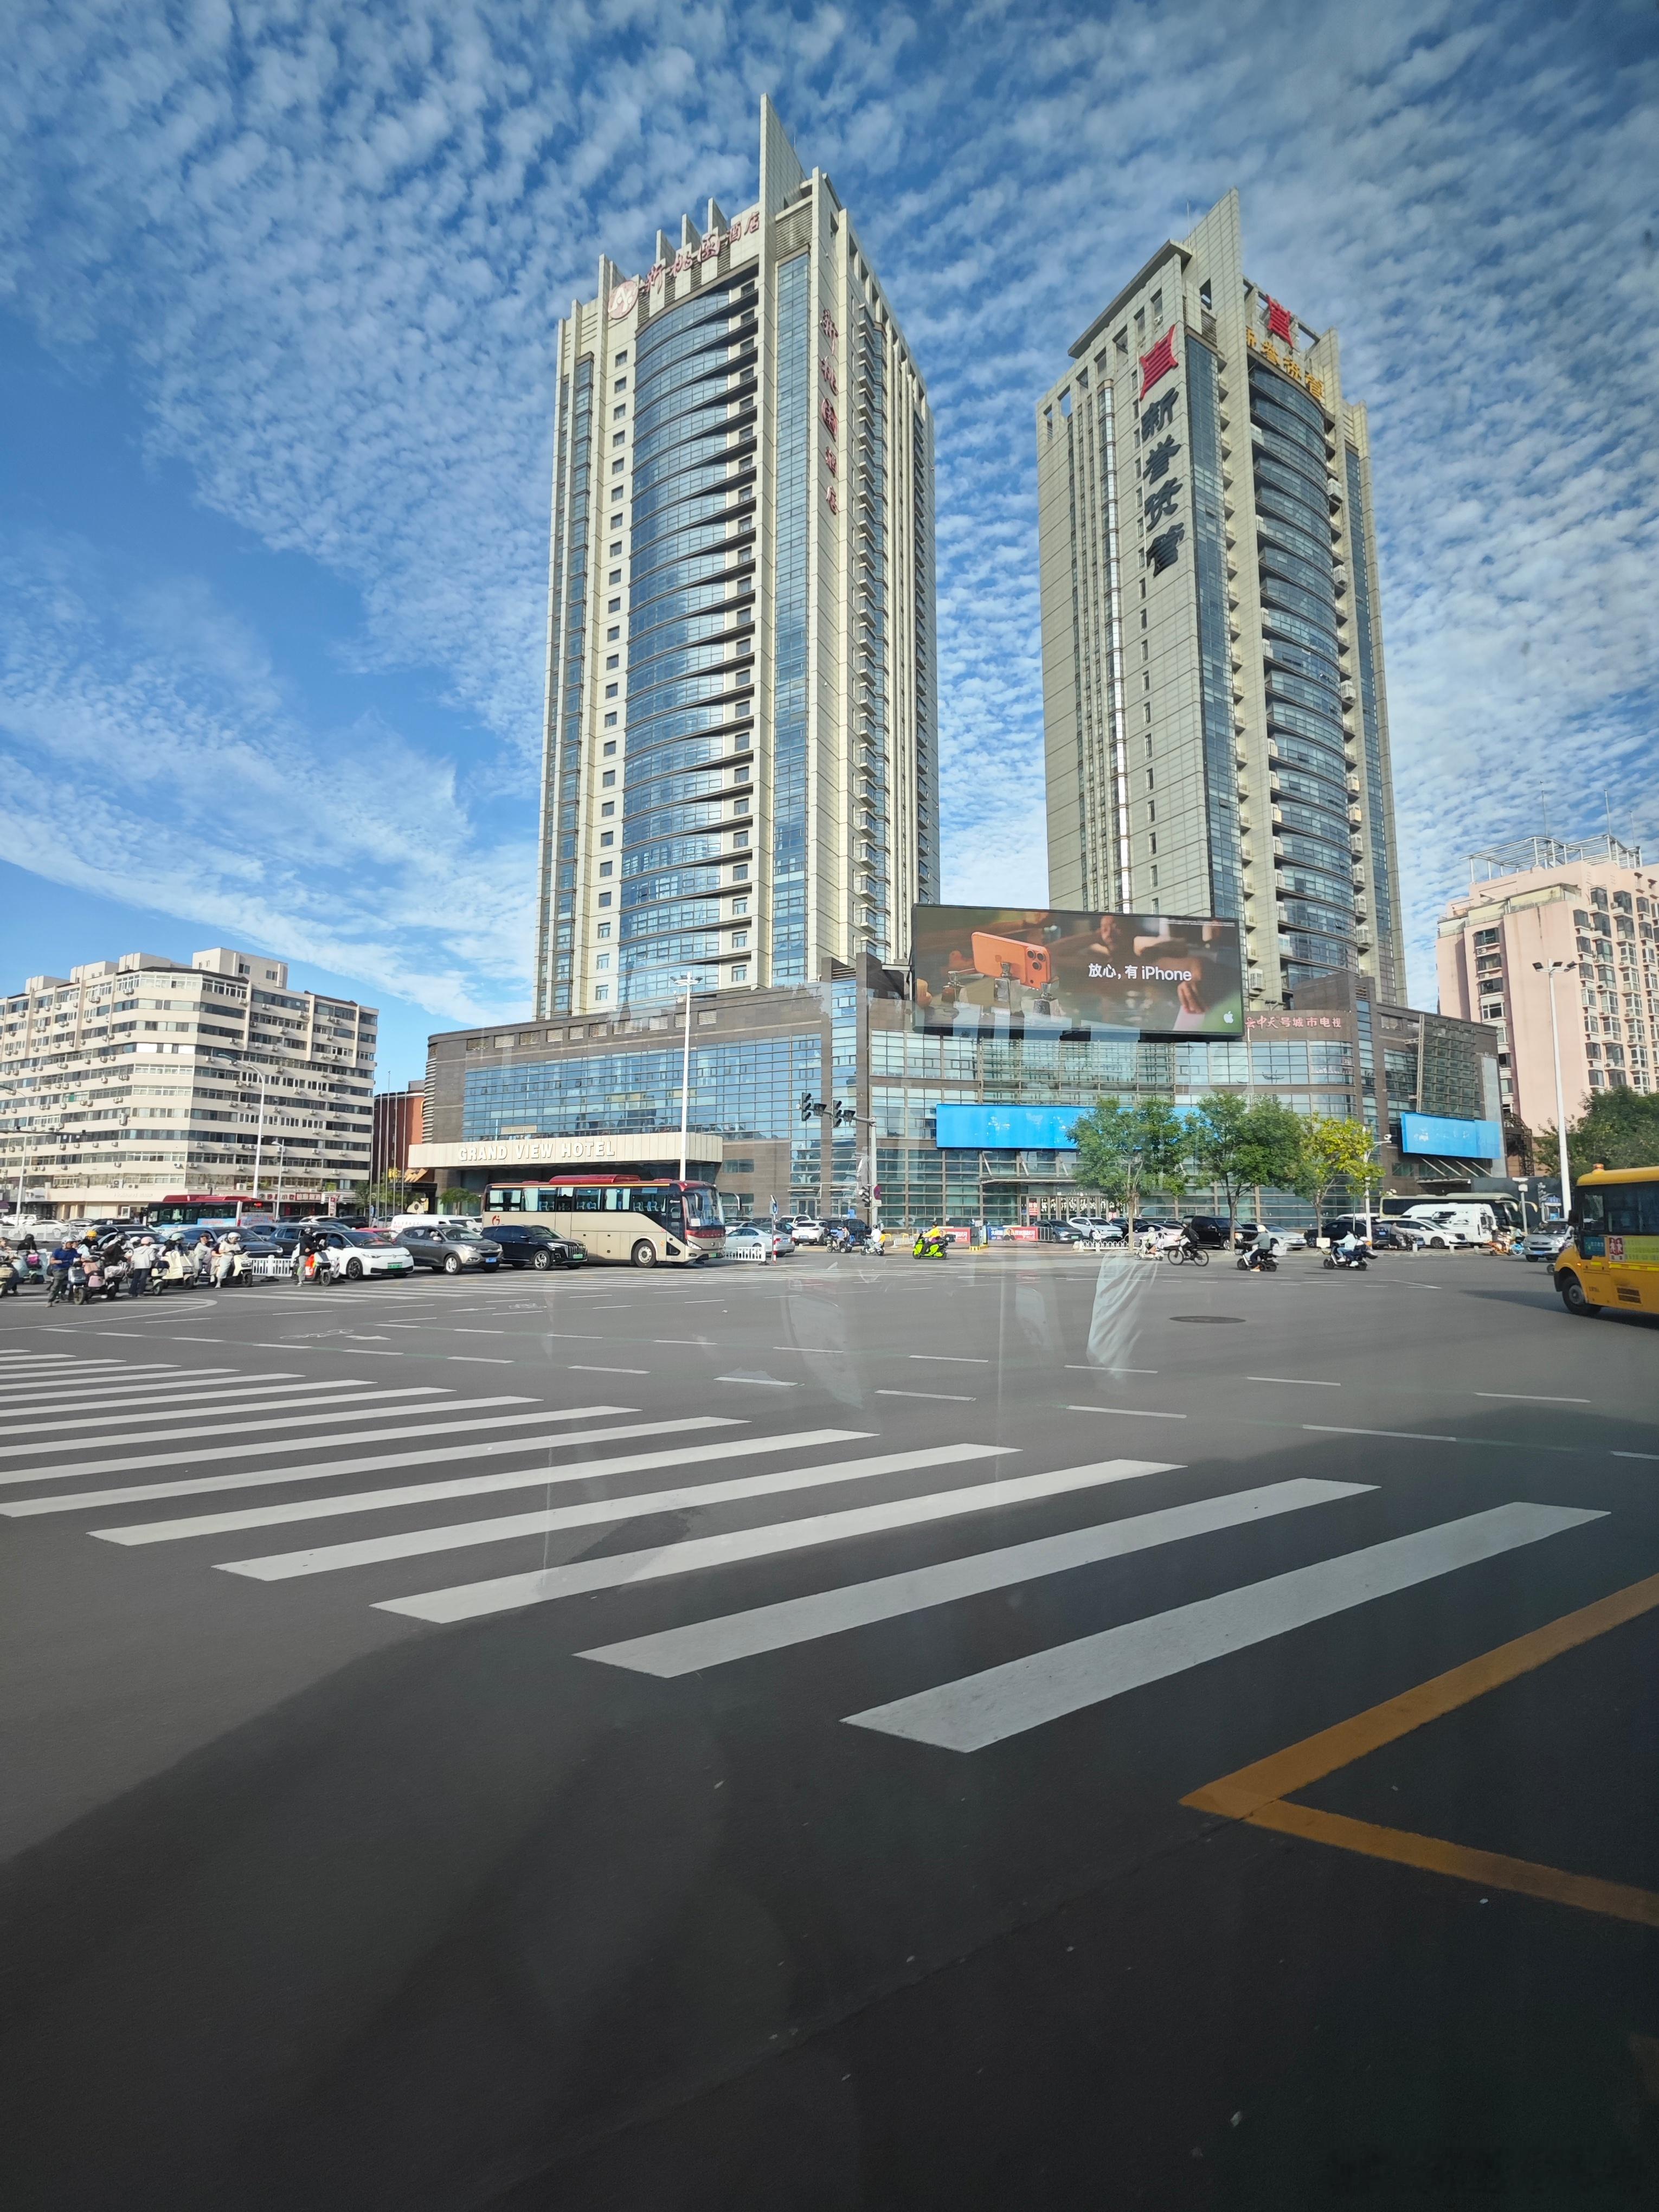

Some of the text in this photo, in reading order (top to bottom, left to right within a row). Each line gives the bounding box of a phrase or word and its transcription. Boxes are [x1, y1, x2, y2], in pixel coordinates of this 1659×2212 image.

[1141, 965, 1192, 981] iPhone
[458, 1140, 615, 1161] GRAND VIEW HOTEL
